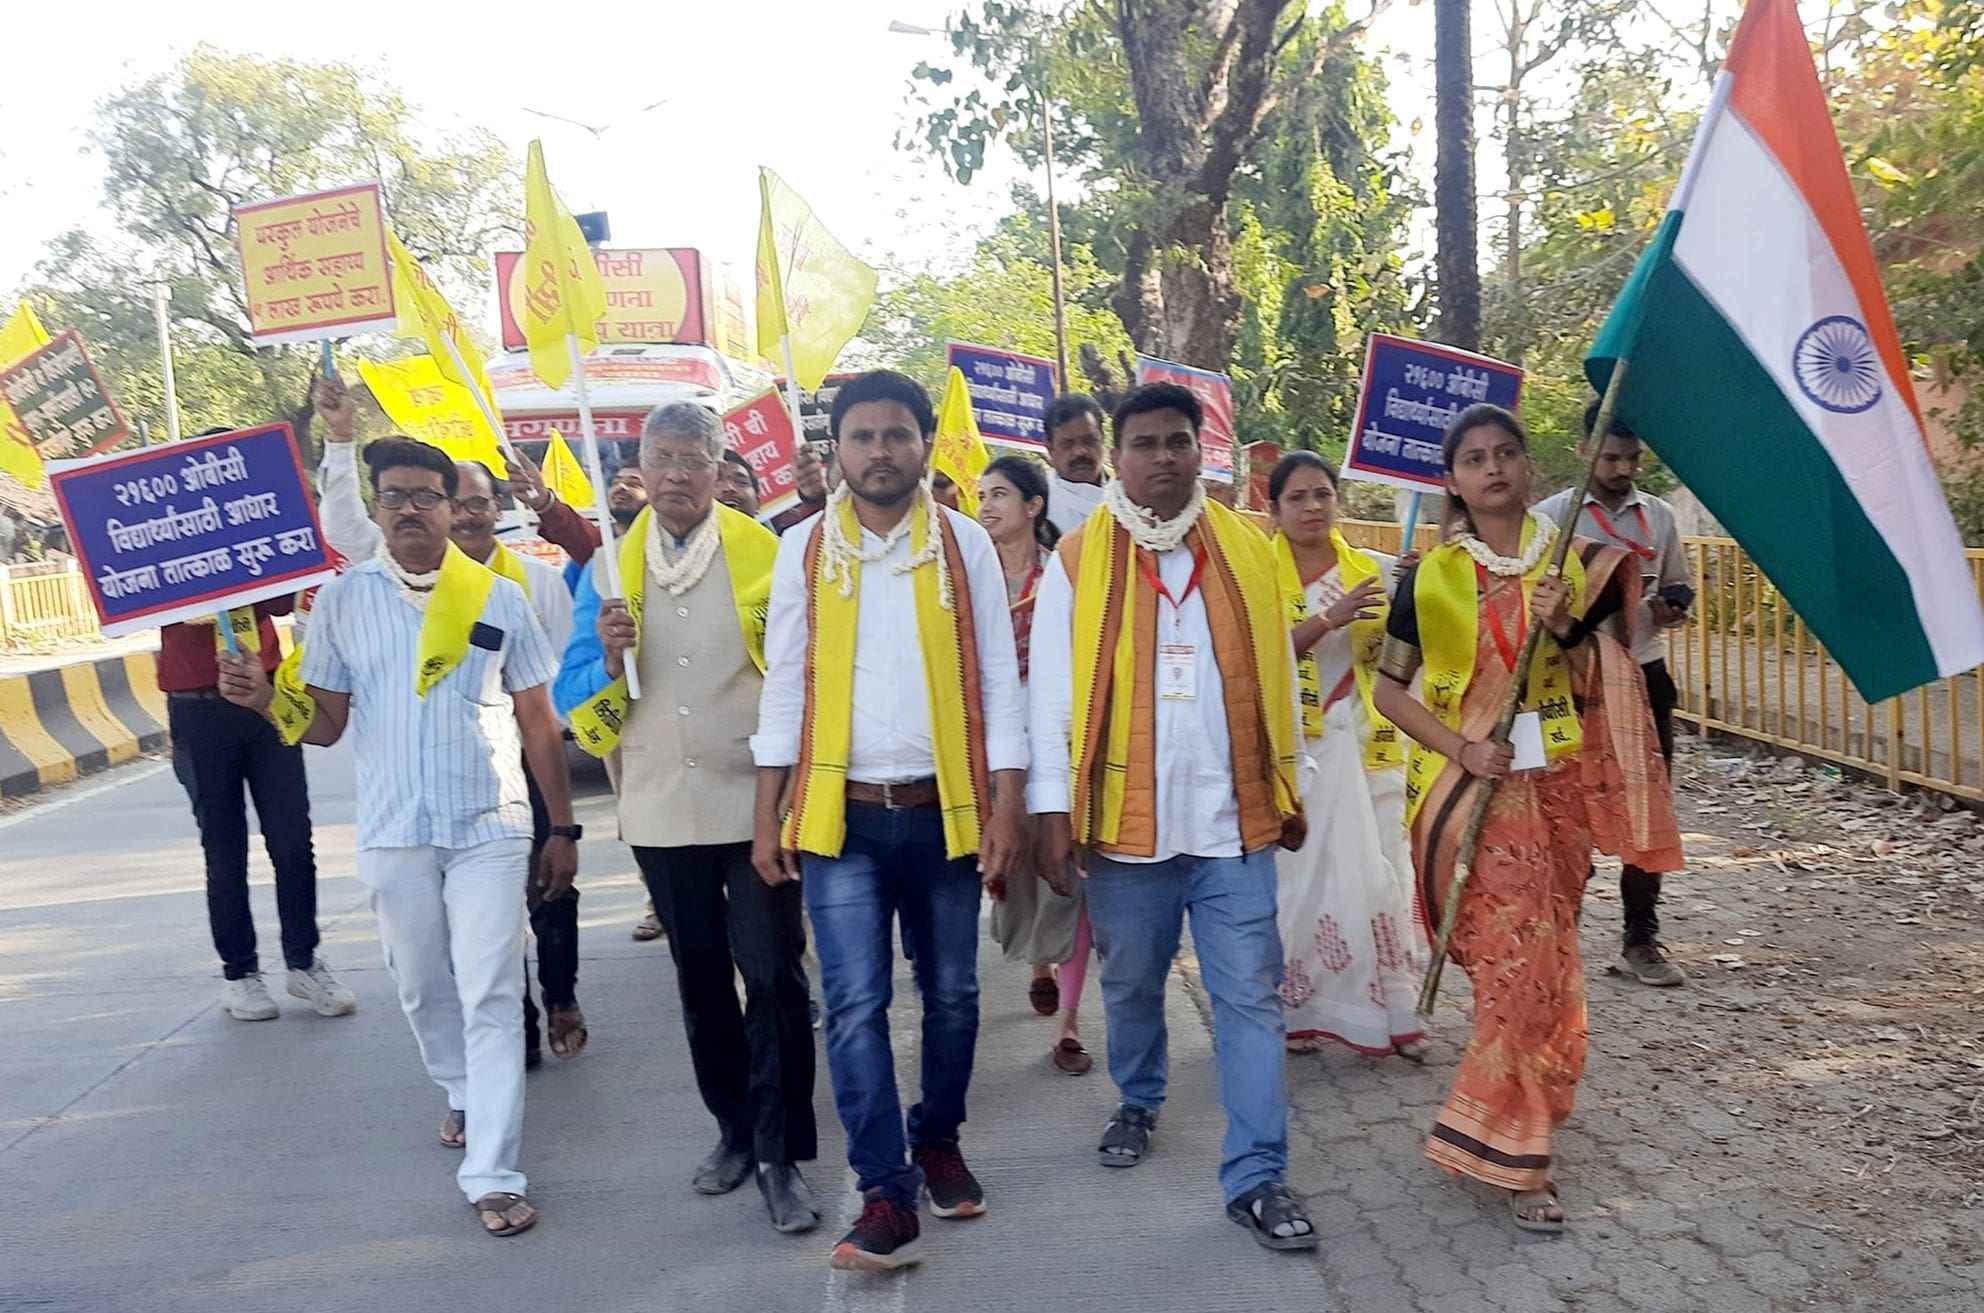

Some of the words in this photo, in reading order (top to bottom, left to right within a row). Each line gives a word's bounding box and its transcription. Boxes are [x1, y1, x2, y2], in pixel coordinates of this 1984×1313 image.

[616, 321, 672, 339] यात्रा
[113, 473, 180, 508] २१६००
[181, 446, 248, 493] ओबीसी
[224, 492, 280, 526] आधार
[98, 566, 159, 600] योजना
[160, 547, 232, 584] तात्काळ
[278, 527, 316, 555] करा
